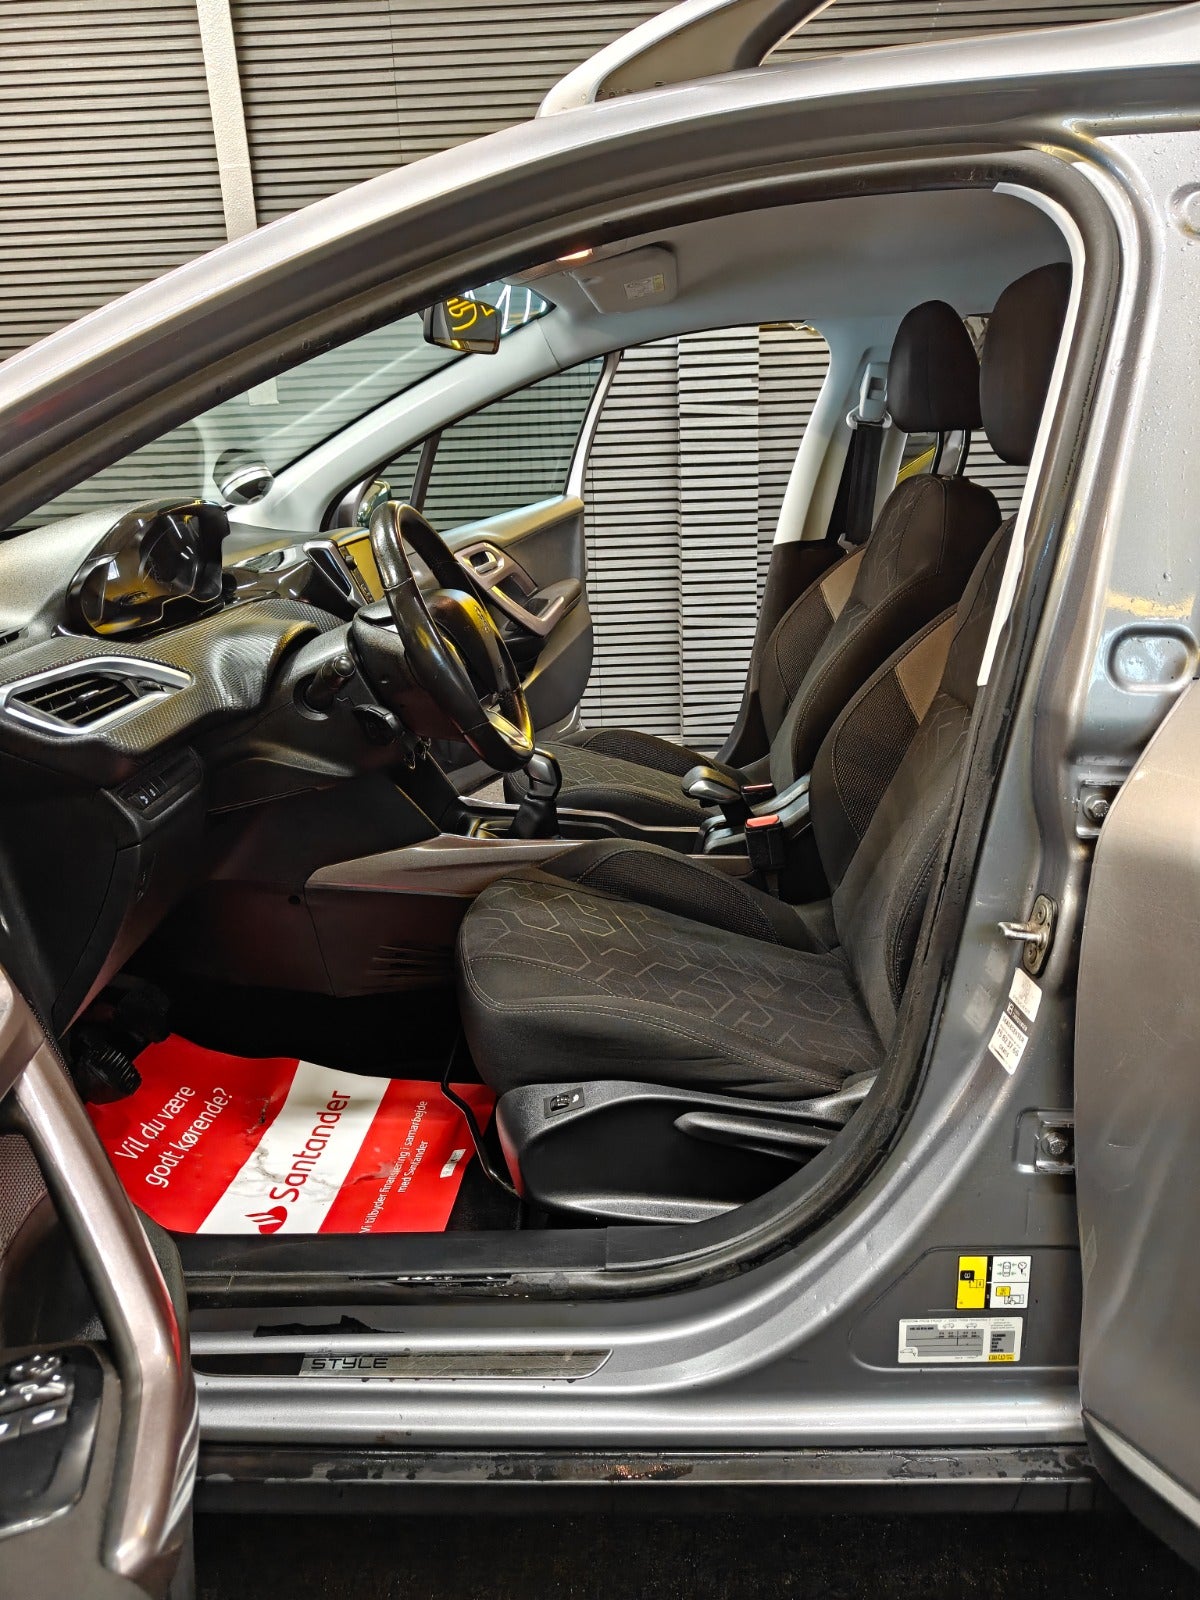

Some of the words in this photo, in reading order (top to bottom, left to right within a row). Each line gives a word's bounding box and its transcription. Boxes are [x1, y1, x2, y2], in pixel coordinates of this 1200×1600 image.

[114, 1136, 149, 1159] Vil
[140, 1118, 167, 1139] du
[157, 1086, 196, 1120] være
[145, 1150, 185, 1188] godt
[168, 1087, 233, 1152] kørende?
[268, 1090, 351, 1202] Santander
[404, 1140, 429, 1176] Santander
[365, 1193, 387, 1224] tilbyder
[379, 1150, 411, 1193] finansiering
[404, 1100, 428, 1146] samarbejde
[397, 1176, 412, 1193] med
[311, 1357, 389, 1369] STYLE
